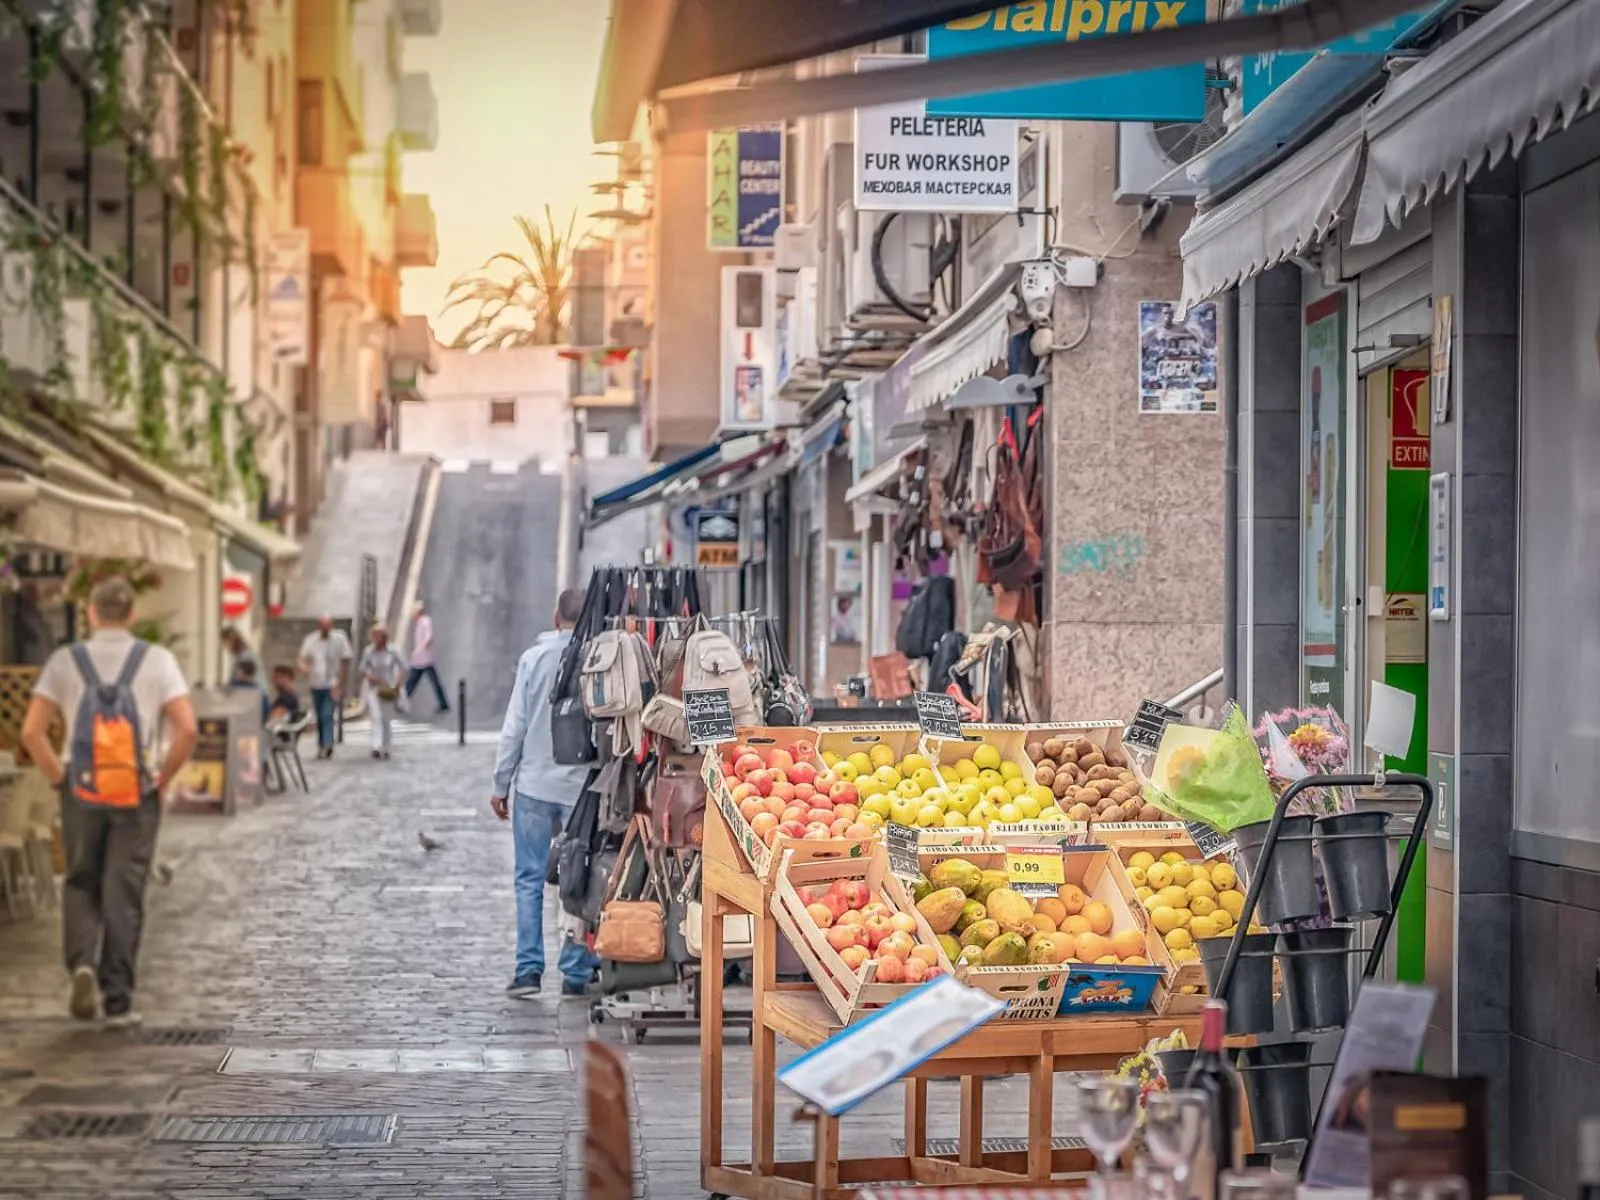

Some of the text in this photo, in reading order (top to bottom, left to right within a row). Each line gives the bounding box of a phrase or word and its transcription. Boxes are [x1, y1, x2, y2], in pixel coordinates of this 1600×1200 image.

[945, 0, 1183, 42] ialprix
[890, 117, 985, 138] PELETERIA
[865, 154, 1010, 172] FUR WORKSHOP
[863, 181, 1011, 196] МЕХОВАЯ МАСТЕРСКАЯ
[996, 823, 1066, 833] GIRONA FRUITS
[1013, 862, 1039, 873] 0,99
[1001, 1009, 1051, 1019] FRUITS
